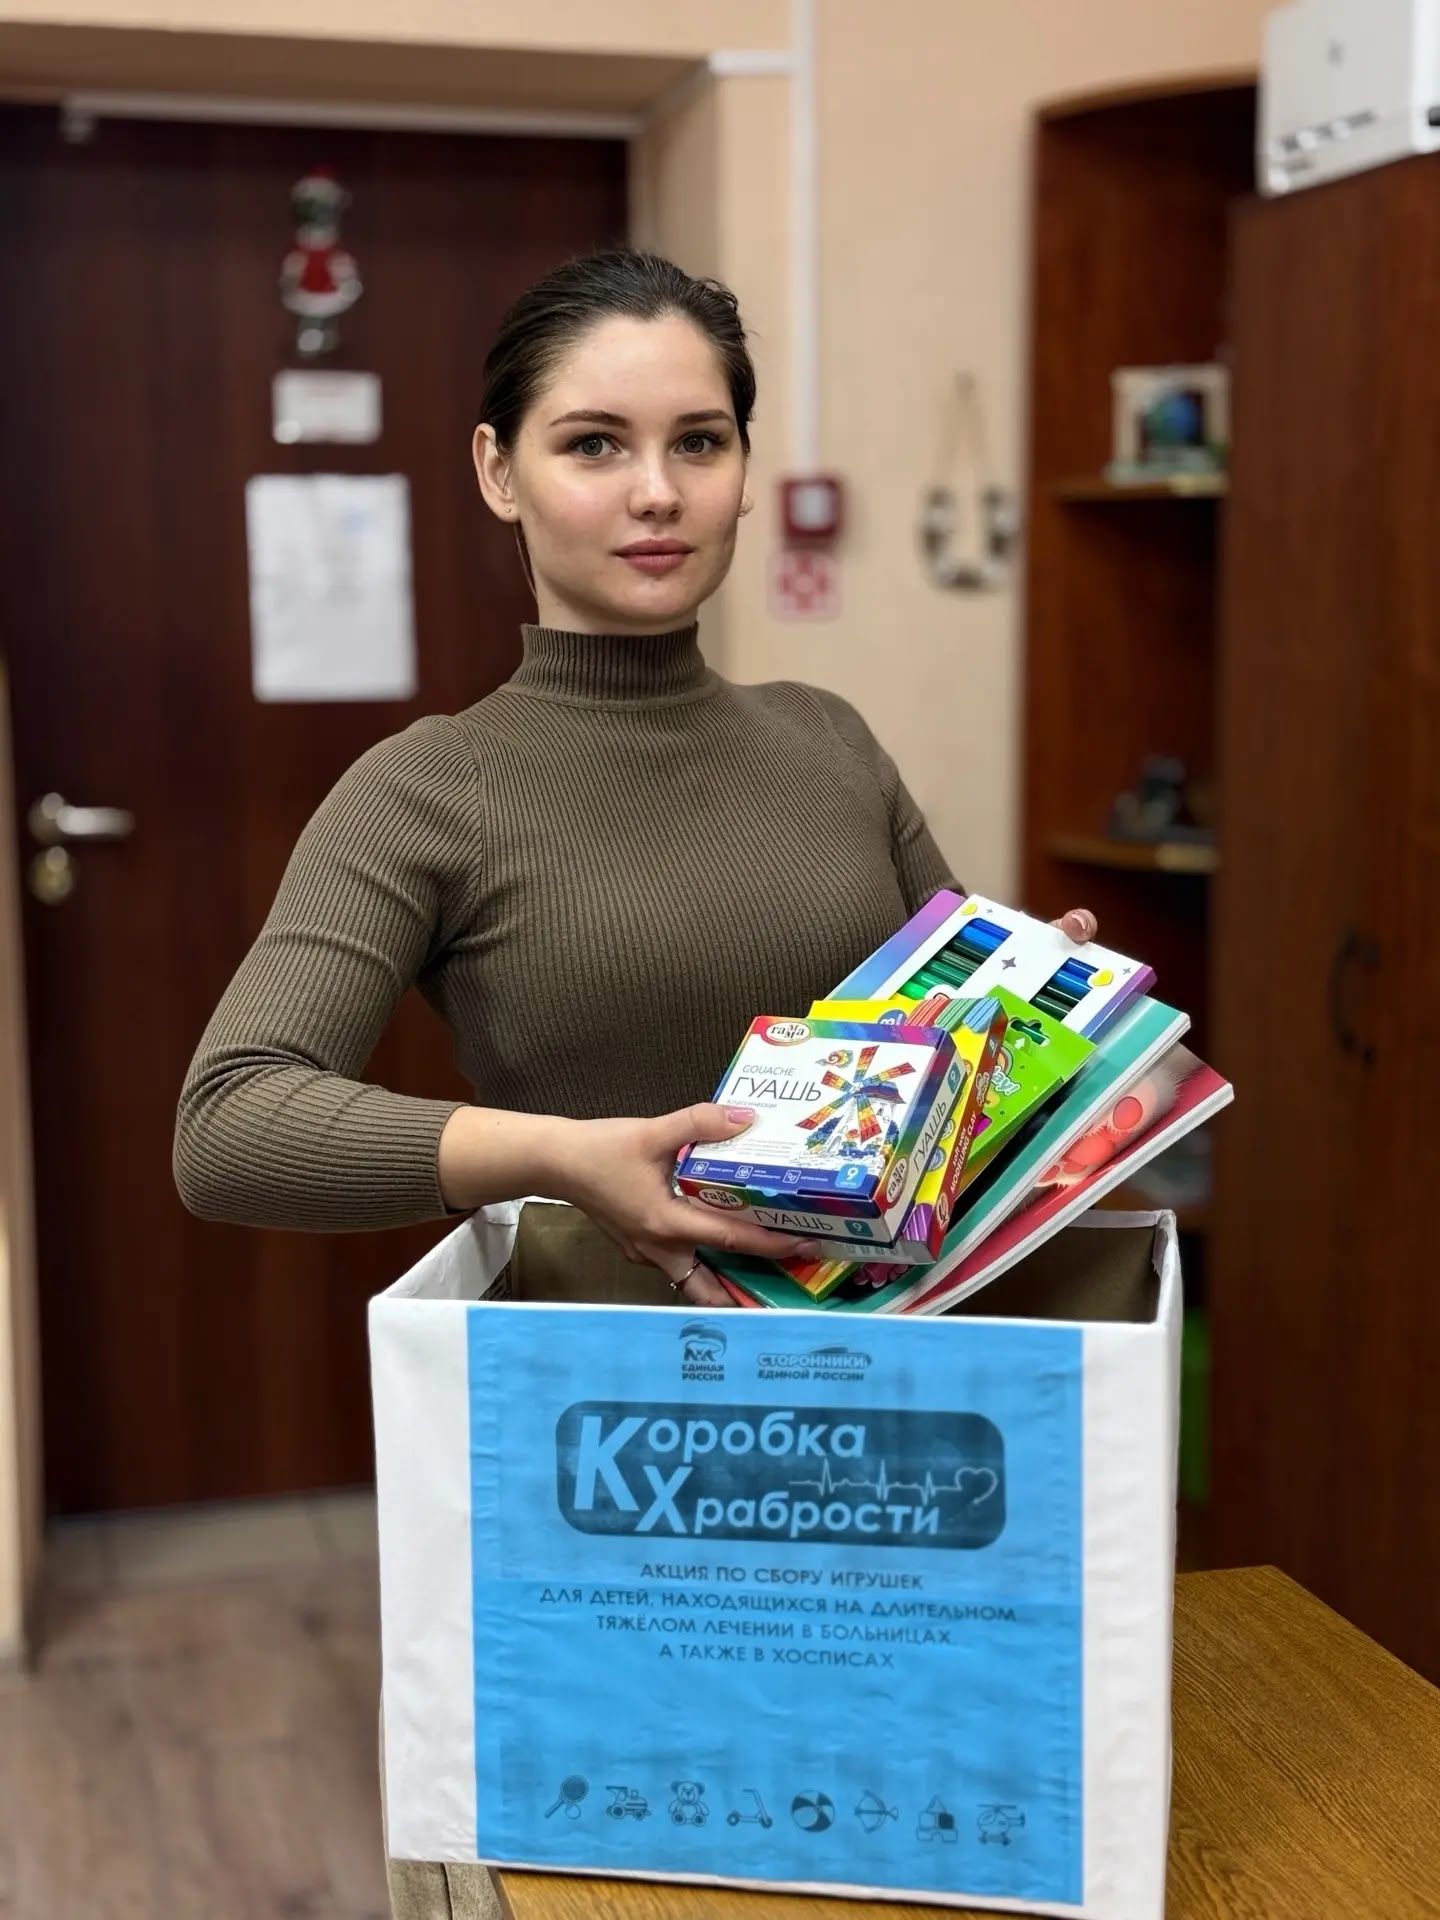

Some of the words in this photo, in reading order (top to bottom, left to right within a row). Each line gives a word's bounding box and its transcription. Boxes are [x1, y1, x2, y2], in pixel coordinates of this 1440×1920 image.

[742, 1064, 796, 1077] GOUACHE
[731, 1076, 822, 1102] ГУАШЬ
[913, 1101, 948, 1173] ГУАШЬ
[950, 1135, 971, 1194] MODELLING
[967, 1111, 977, 1138] CLAY
[847, 1167, 859, 1181] 9
[754, 1209, 835, 1232] ГУАШЬ
[682, 1363, 725, 1373] ЕДИНАЯ
[757, 1353, 866, 1370] СТОРОННИКИ
[682, 1372, 725, 1382] РОССИЯ
[757, 1369, 810, 1381] ЕДИНОЙ
[813, 1371, 865, 1382] РОССИИ
[574, 1412, 866, 1512] Коробка
[635, 1464, 940, 1539] Храбрости
[640, 1563, 709, 1581] АКЦИЯ
[716, 1566, 746, 1583] ПО
[754, 1568, 823, 1586] СБОРУ
[831, 1571, 923, 1590] ИГРУШЕК
[540, 1588, 583, 1604] ДЛЯ
[662, 1592, 827, 1613] НАХОДЯЩИХСЯ
[835, 1599, 864, 1615] НА
[870, 1601, 1017, 1622] ДЛИТЕЛЬНОМ
[597, 1613, 696, 1633] ТЯЖЁЛОМ
[703, 1620, 794, 1639] ЛЕЧЕНИИ
[802, 1623, 813, 1639] В
[659, 1643, 674, 1660] А
[680, 1644, 746, 1662] ТАКЖЕ
[753, 1647, 765, 1663] В
[773, 1648, 894, 1669] ХОСПИСАХ
